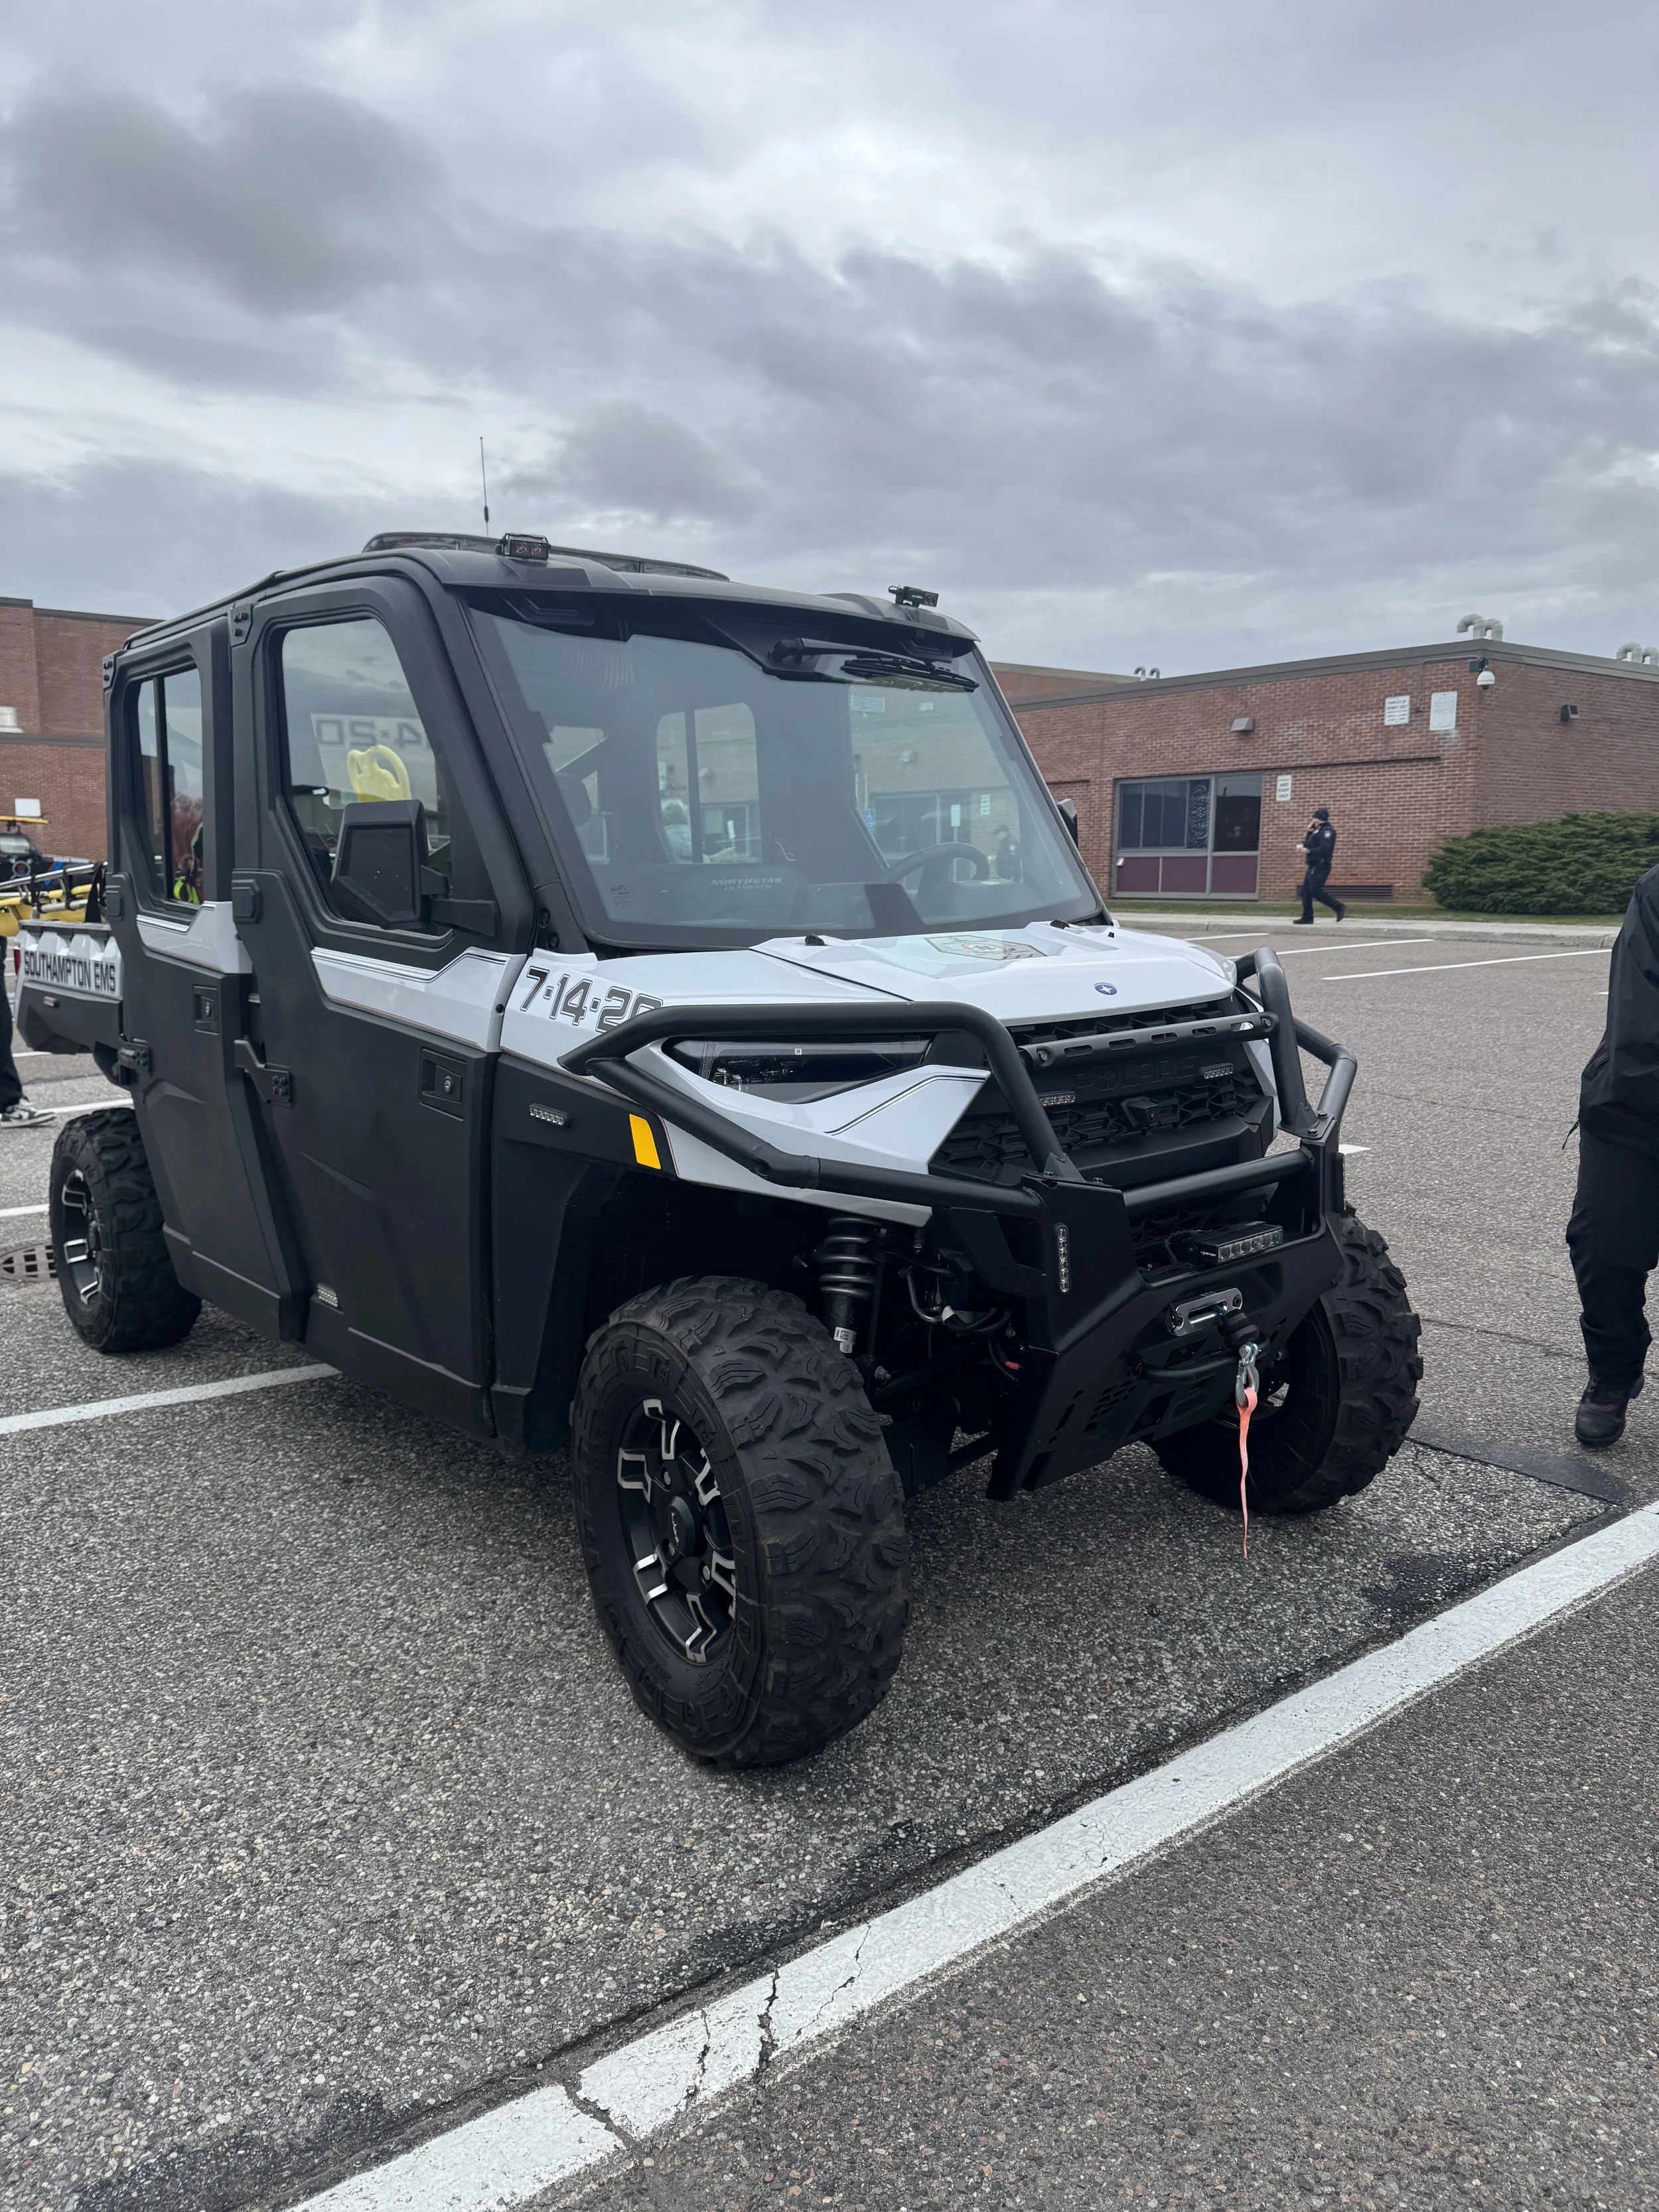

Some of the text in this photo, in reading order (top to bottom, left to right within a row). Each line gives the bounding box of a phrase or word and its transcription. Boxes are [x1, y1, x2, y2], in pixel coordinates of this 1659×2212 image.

[710, 877, 783, 886] NORTHSTAR
[24, 950, 116, 994] SOUTHAMPTON EMS
[1074, 1055, 1199, 1092] POLARIS
